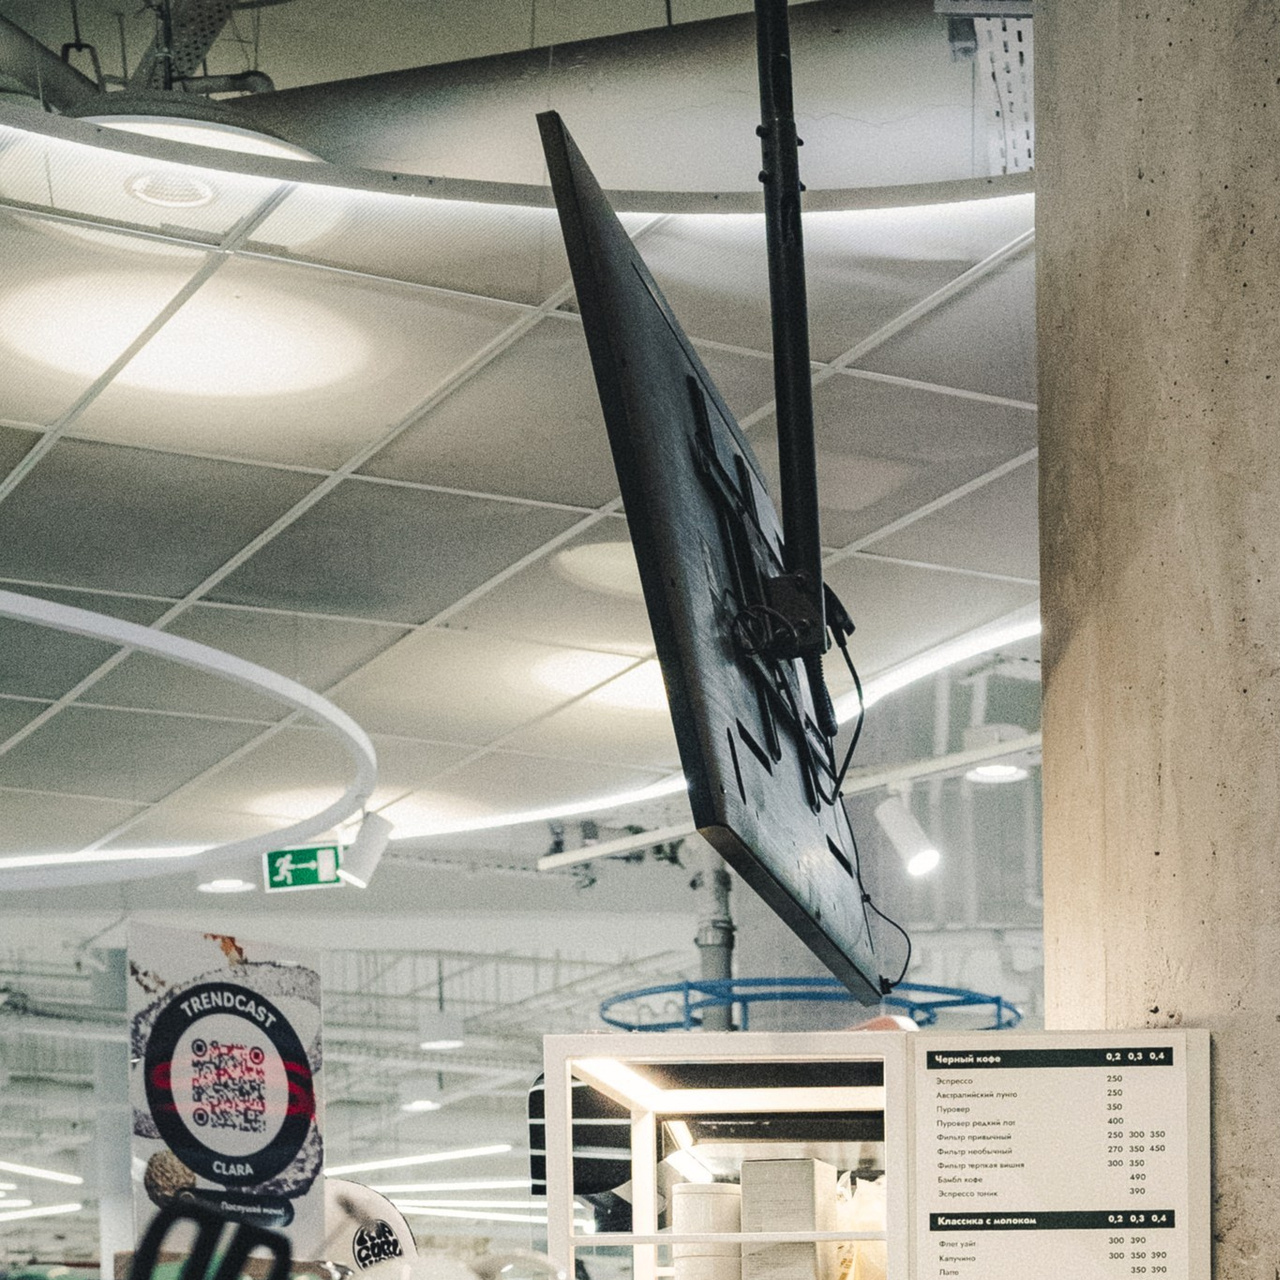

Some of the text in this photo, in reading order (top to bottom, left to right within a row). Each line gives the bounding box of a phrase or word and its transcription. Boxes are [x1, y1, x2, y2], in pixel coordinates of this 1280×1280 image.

[180, 992, 276, 1028] TRENDCAST
[934, 1052, 1165, 1065] Черный кофе 0,2 0,3 0,4
[936, 1077, 973, 1086] Эспрессо
[936, 1103, 1123, 1114] Пуровер 350
[936, 1119, 970, 1128] Пуровер
[1107, 1117, 1124, 1125] 400
[936, 1133, 965, 1142] Фильтр
[1107, 1131, 1124, 1139] 250
[1150, 1130, 1166, 1138] 350
[936, 1147, 966, 1157] Фильтр
[1149, 1144, 1166, 1152] 450
[213, 1161, 253, 1175] CLARA
[937, 1161, 966, 1171] Фильтр
[1129, 1159, 1145, 1167] 350
[964, 1175, 982, 1185] кофе
[938, 1190, 974, 1199] Эспрессо
[937, 1215, 983, 1225] Классика
[1108, 1215, 1123, 1224] 0,2
[1130, 1214, 1145, 1224] 0,3
[1151, 1214, 1167, 1223] 0,4
[1130, 1236, 1146, 1244] 390
[357, 1238, 402, 1263] CURL
[938, 1254, 976, 1263] Капучино
[1109, 1252, 1125, 1260] 300
[1151, 1251, 1167, 1259] 390
[1131, 1266, 1147, 1274] 350
